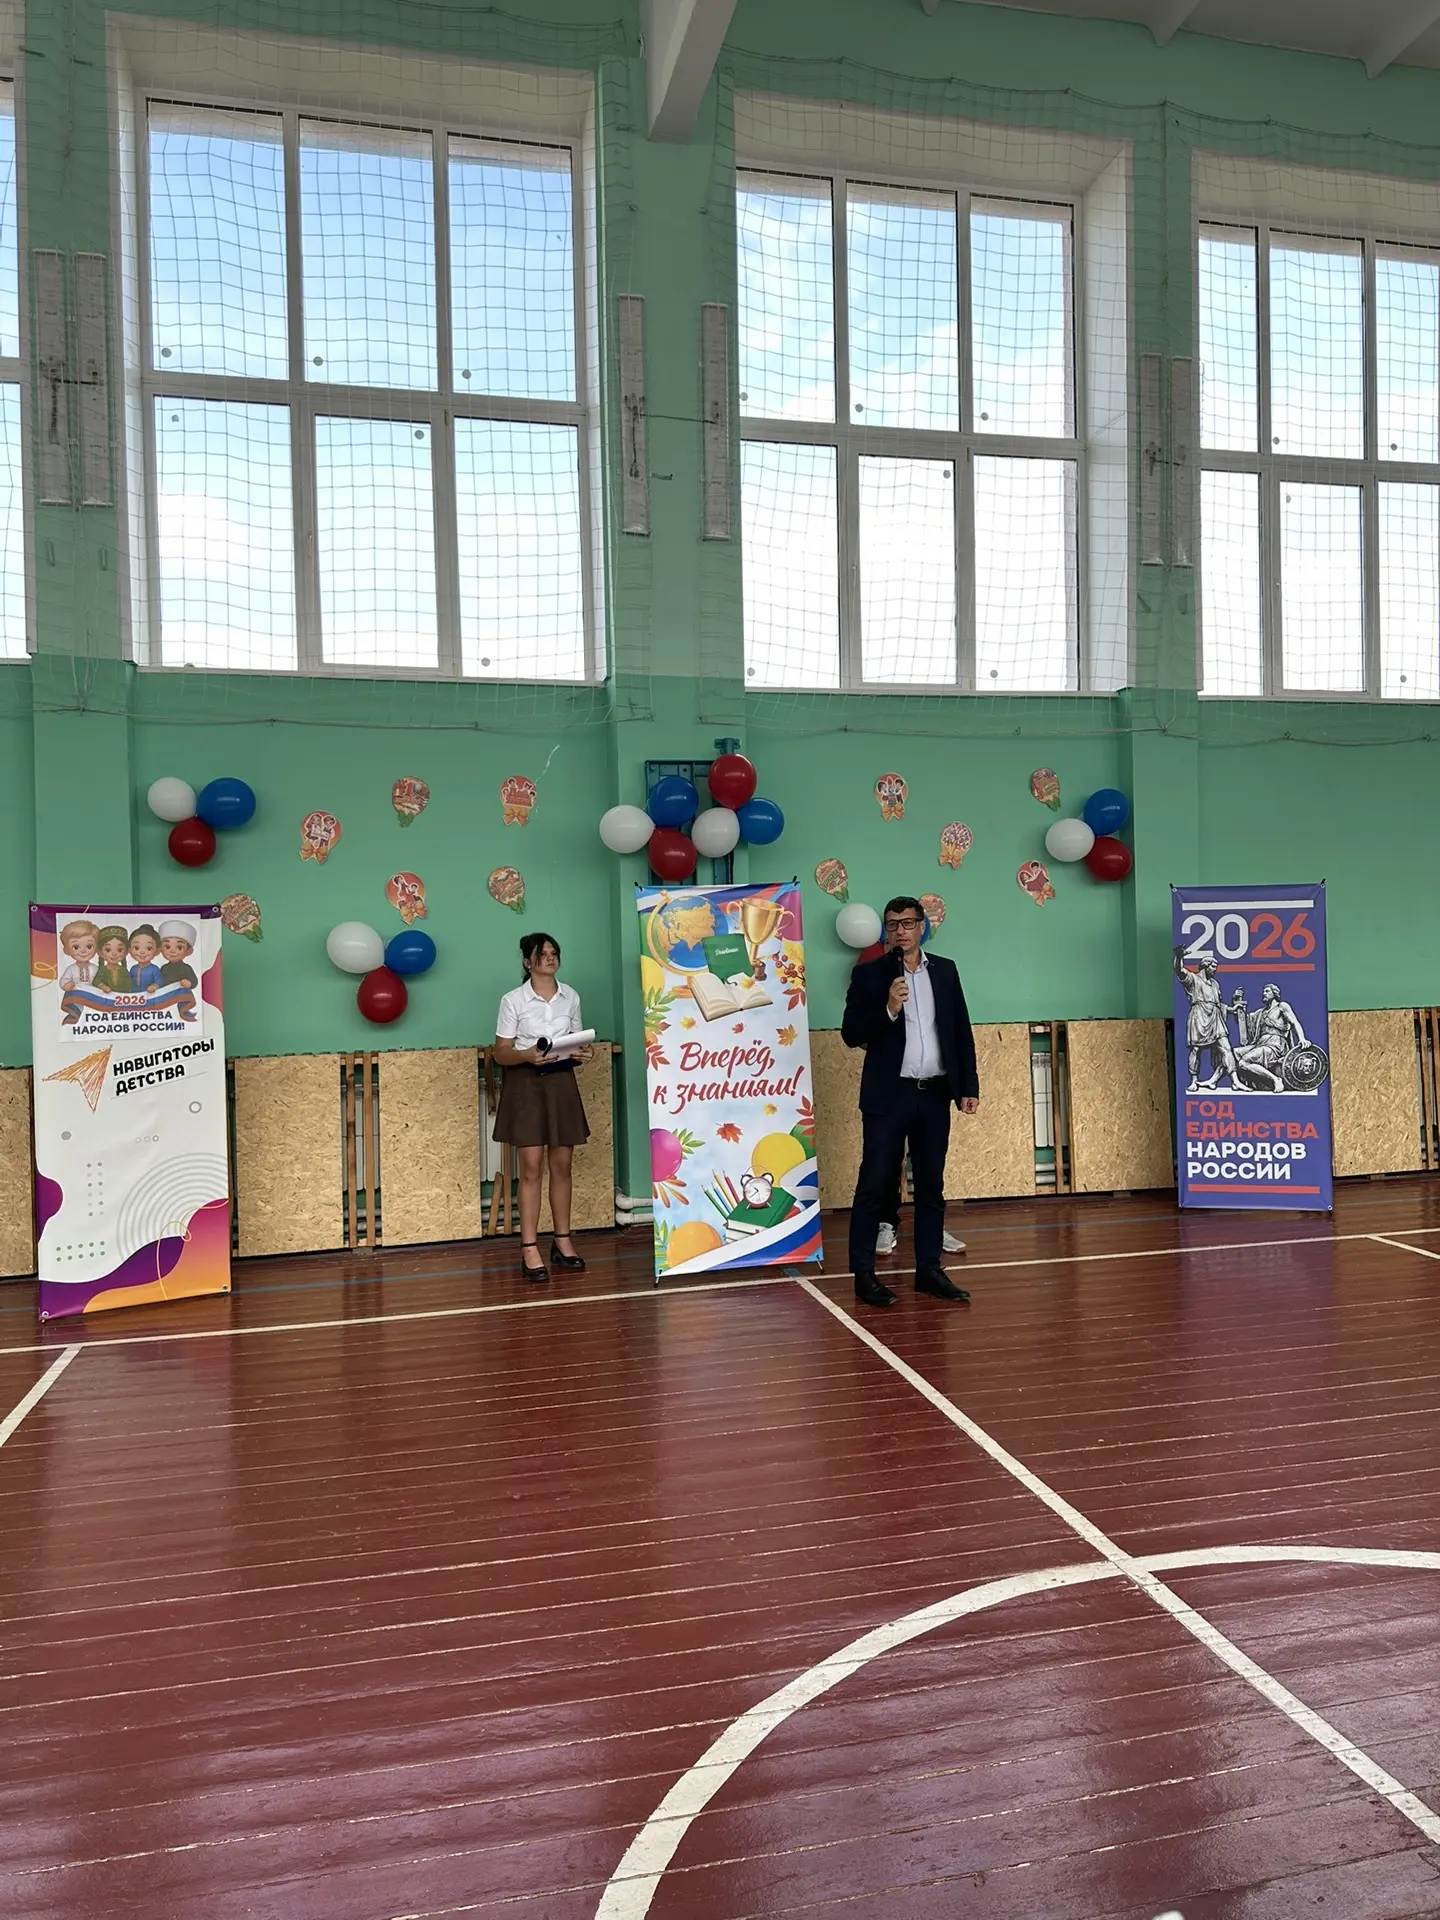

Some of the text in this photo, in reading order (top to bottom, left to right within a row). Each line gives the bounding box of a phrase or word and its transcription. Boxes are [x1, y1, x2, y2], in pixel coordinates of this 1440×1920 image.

[1181, 913, 1316, 960] 2026
[115, 995, 146, 1006] 2026
[85, 1011, 173, 1022] ГОД ЕДИНСТВА
[73, 1022, 185, 1035] НАРОДОВ РОССИИ!
[113, 1038, 214, 1076] НАВИГАТОРЫ
[680, 1040, 775, 1078] Вперёд,
[116, 1064, 185, 1096] ДЕТСТВА
[653, 1065, 805, 1115] к знаниям!
[1186, 1101, 1235, 1119] ГОД
[1186, 1122, 1319, 1140] ЕДИНСТВА
[1187, 1142, 1306, 1161] НАРОДОВ
[1188, 1162, 1291, 1180] РОССИИ
